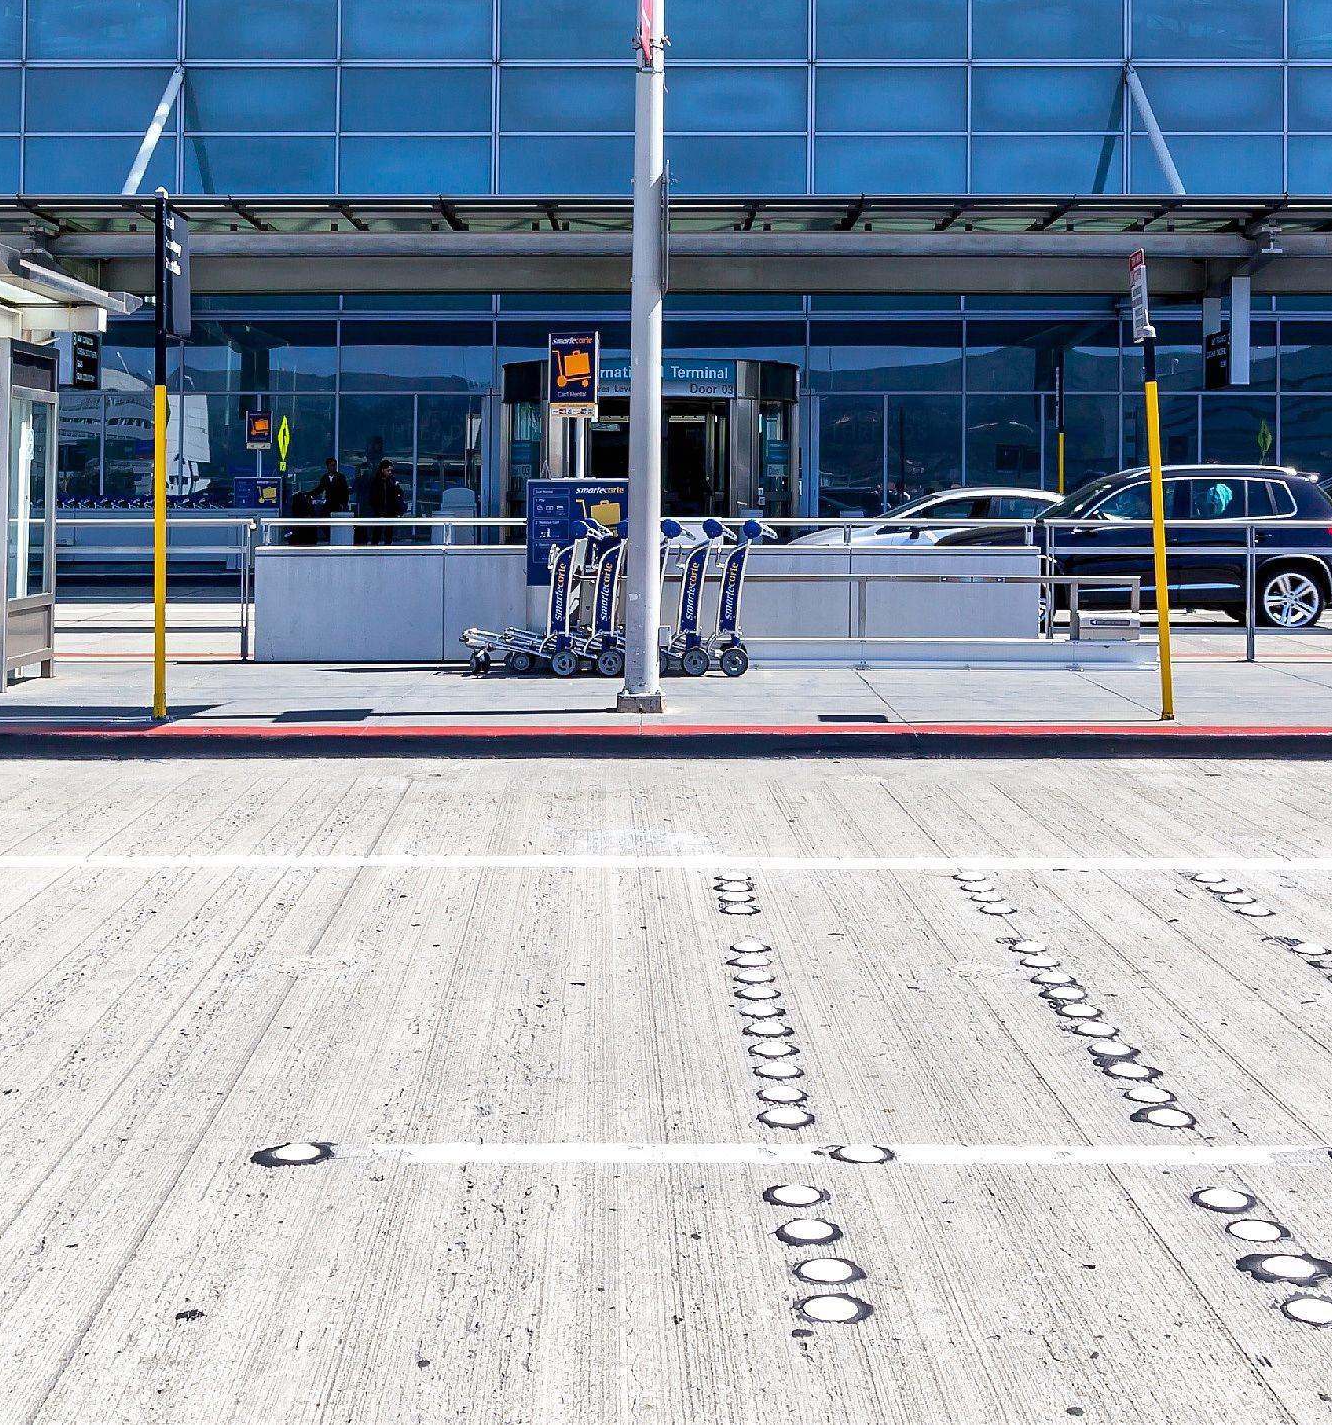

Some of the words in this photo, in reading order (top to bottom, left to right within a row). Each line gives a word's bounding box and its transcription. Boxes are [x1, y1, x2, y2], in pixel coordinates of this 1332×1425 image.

[671, 365, 728, 379] Terminal
[689, 383, 717, 394] Door
[721, 385, 734, 394] 03
[575, 486, 625, 495] smartecarte
[554, 562, 567, 621] smartecarte
[599, 562, 613, 621] smartecarte
[685, 562, 700, 621] smartecarte
[725, 562, 739, 621] smartecarte
